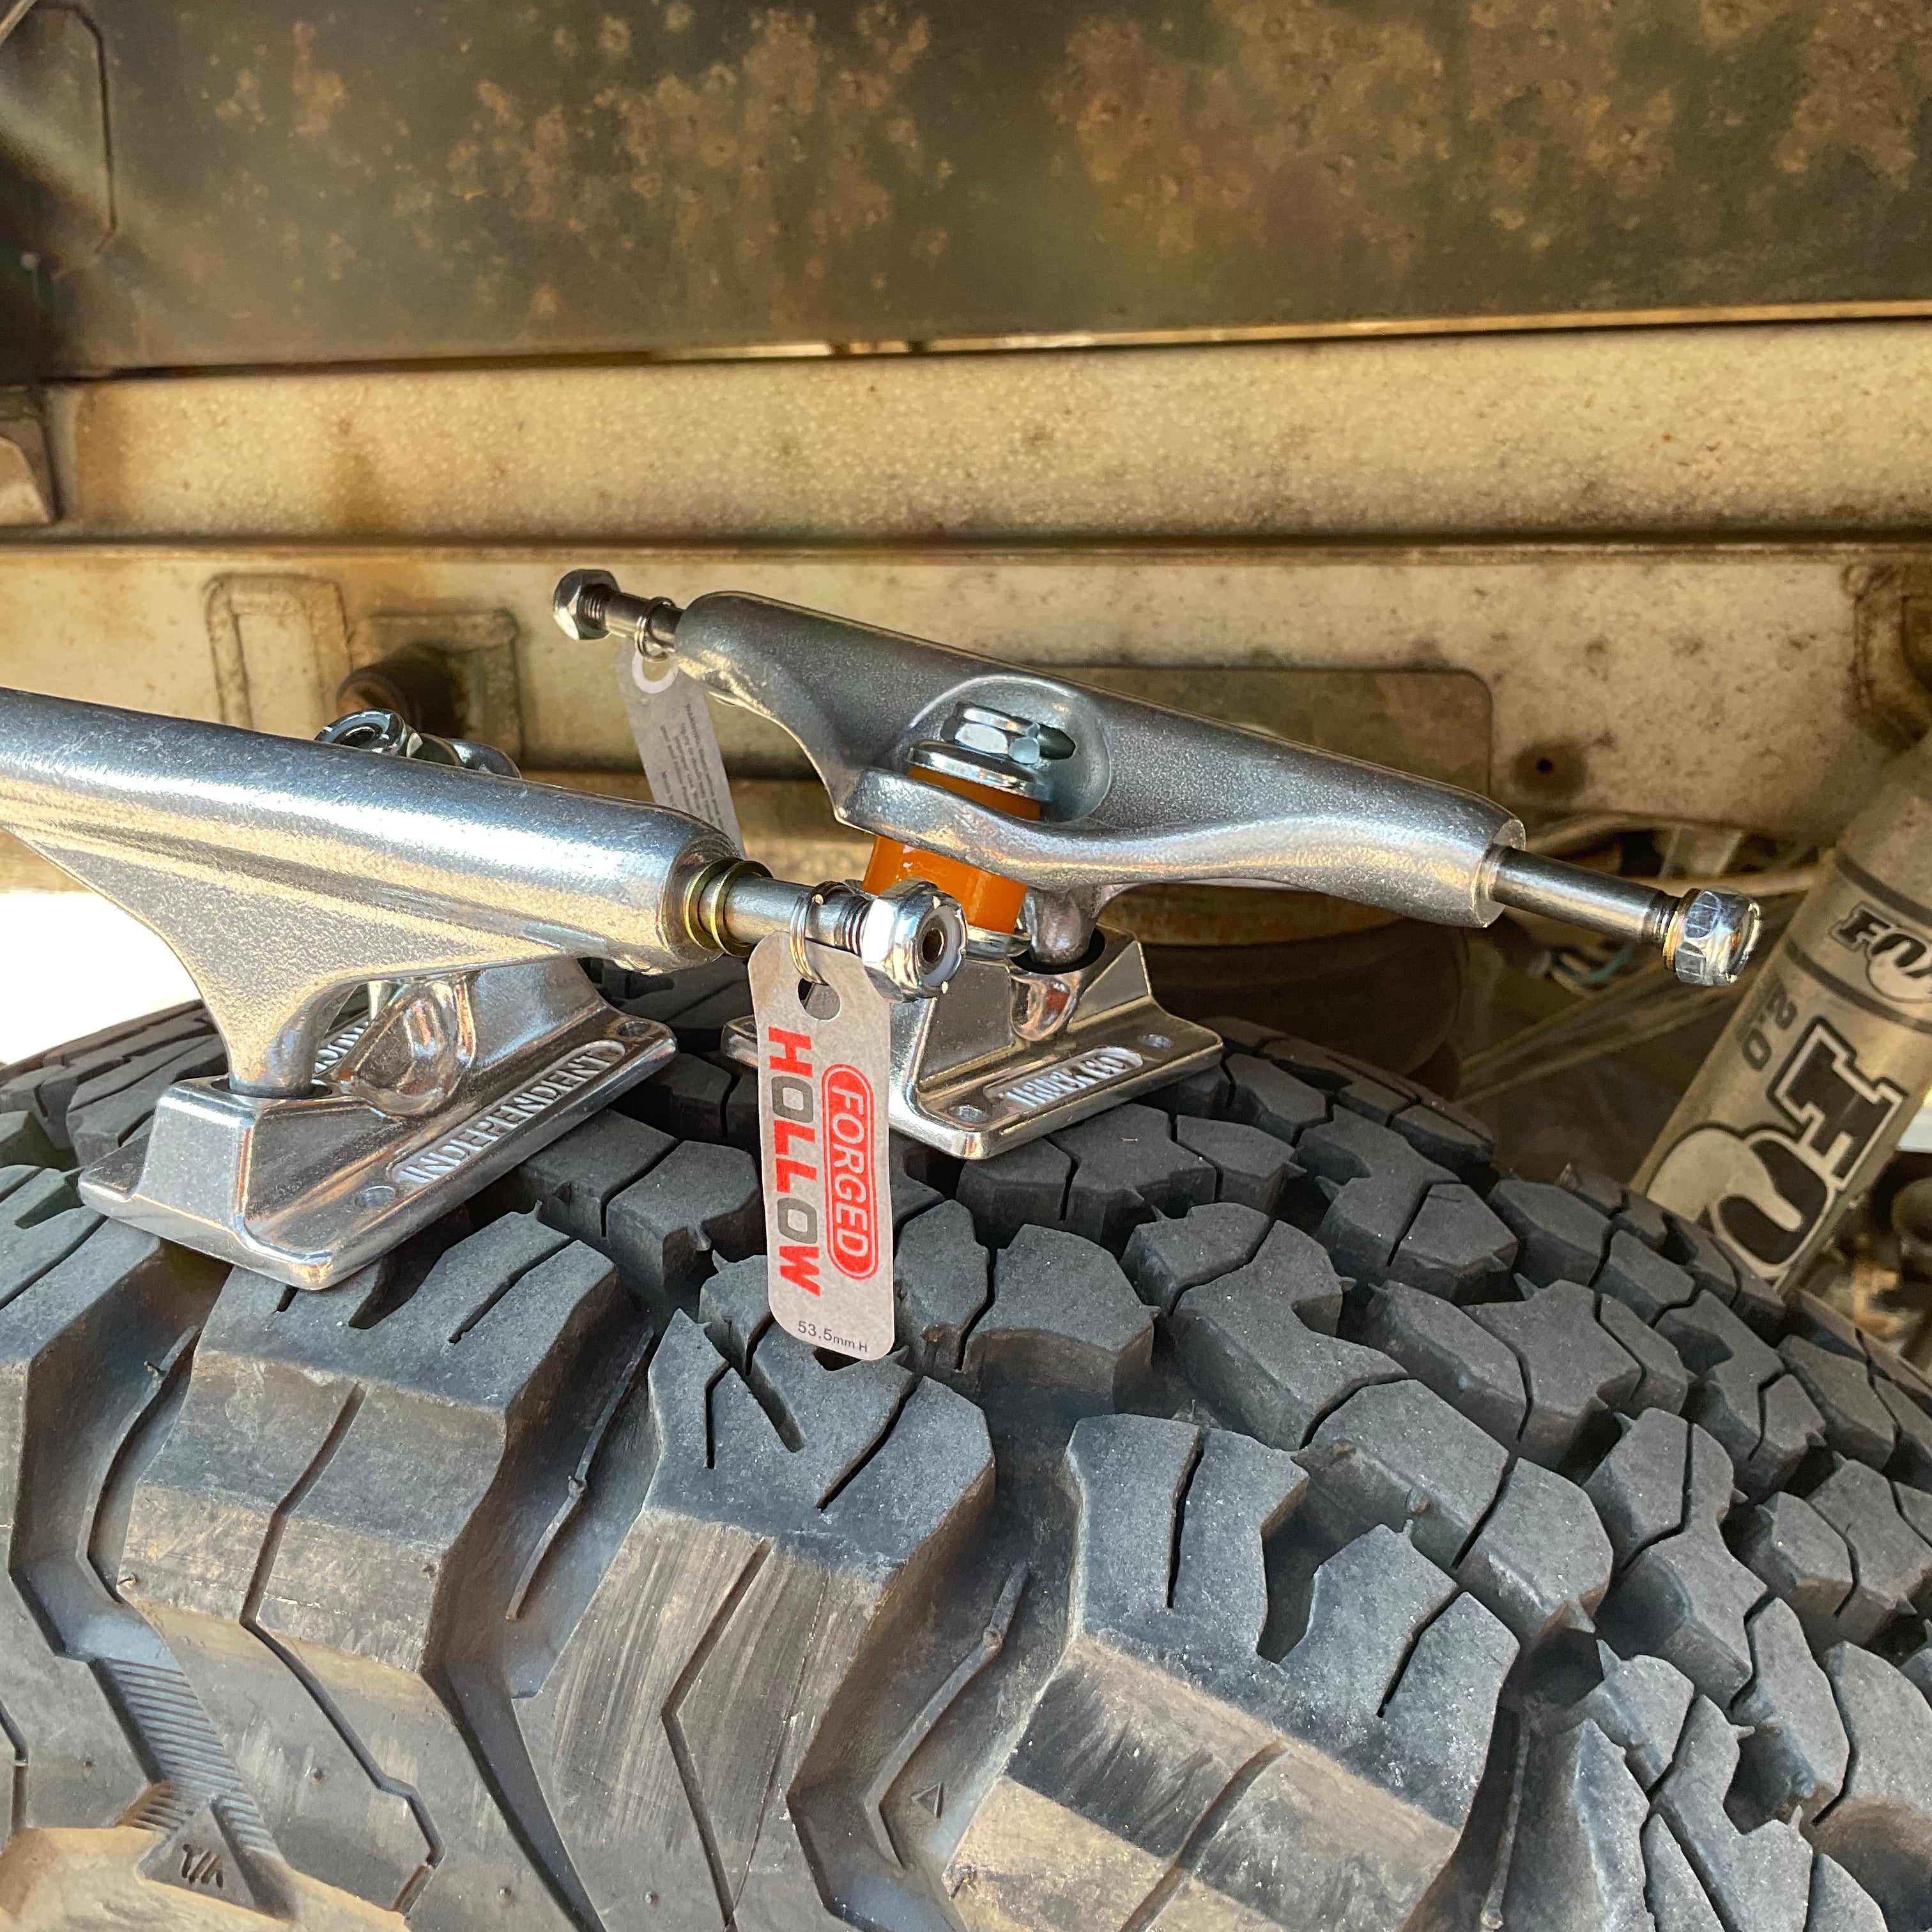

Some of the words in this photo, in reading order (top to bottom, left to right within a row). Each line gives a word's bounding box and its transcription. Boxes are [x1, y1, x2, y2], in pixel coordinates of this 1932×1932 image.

[1830, 902, 1932, 1003] FO
[1742, 974, 1798, 1071] 2.0
[397, 1052, 611, 1183] INDEPENDENT
[768, 1027, 821, 1296] HOLLOW
[830, 1085, 869, 1257] FORGED
[1647, 1015, 1908, 1287] FO
[797, 1320, 855, 1349] 53.5mm
[859, 1341, 868, 1353] H
